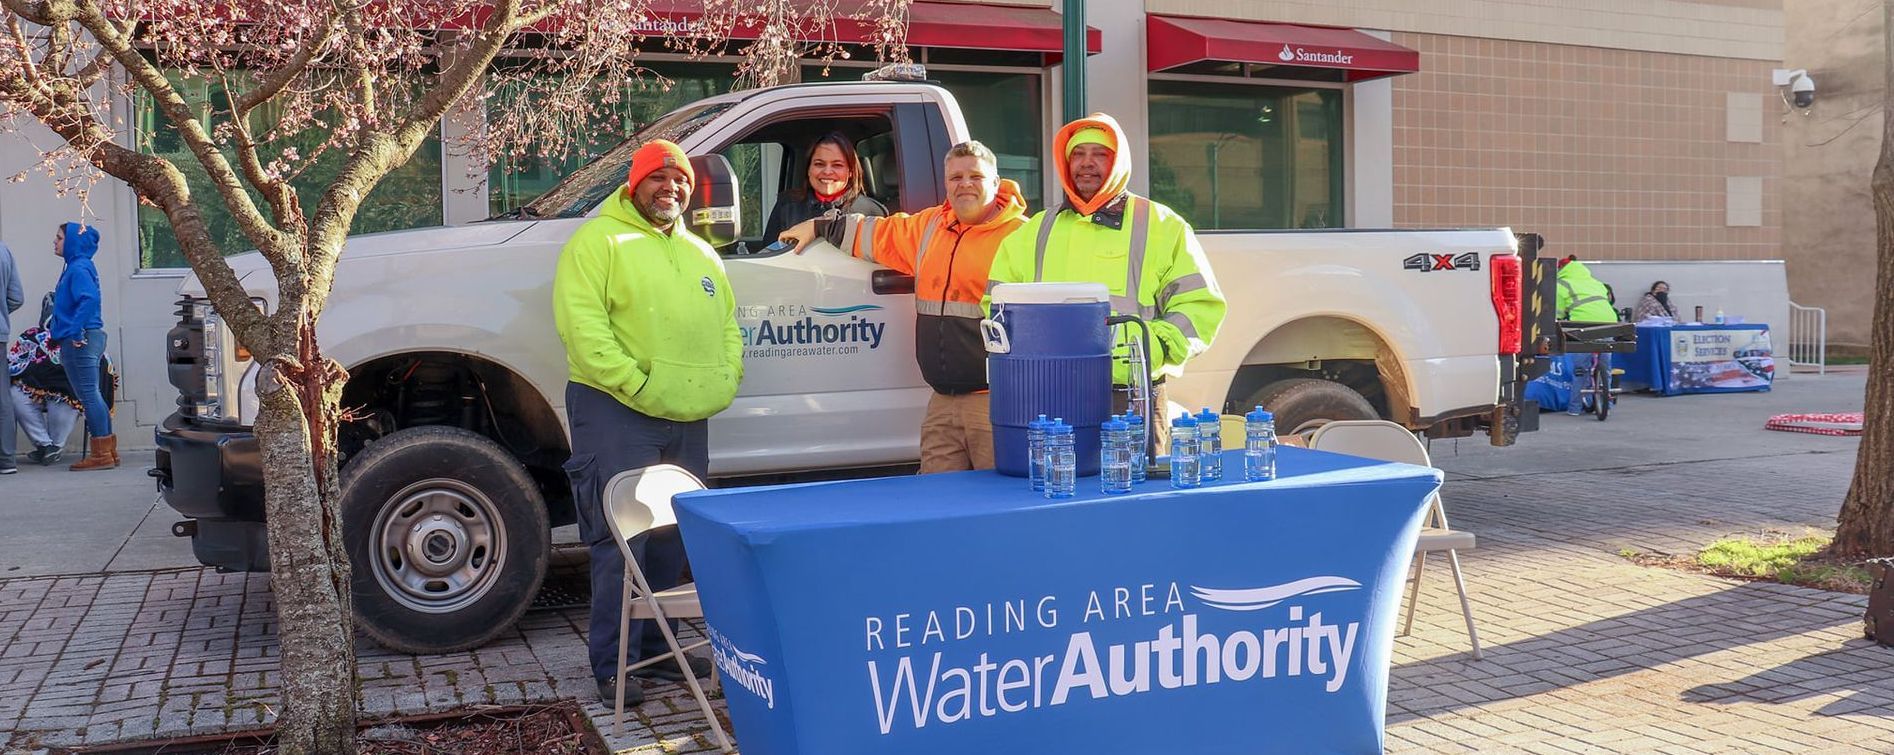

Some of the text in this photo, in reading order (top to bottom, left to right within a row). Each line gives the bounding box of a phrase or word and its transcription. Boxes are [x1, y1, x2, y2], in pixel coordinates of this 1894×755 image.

[1296, 48, 1353, 64] Santander
[767, 305, 807, 318] AREA
[741, 316, 885, 349] erAuthority
[1693, 334, 1732, 344] ELECTION
[742, 345, 859, 359] .readingareawater.com
[866, 581, 1185, 651] READING AREA
[867, 606, 1360, 735] WaterAuthority
